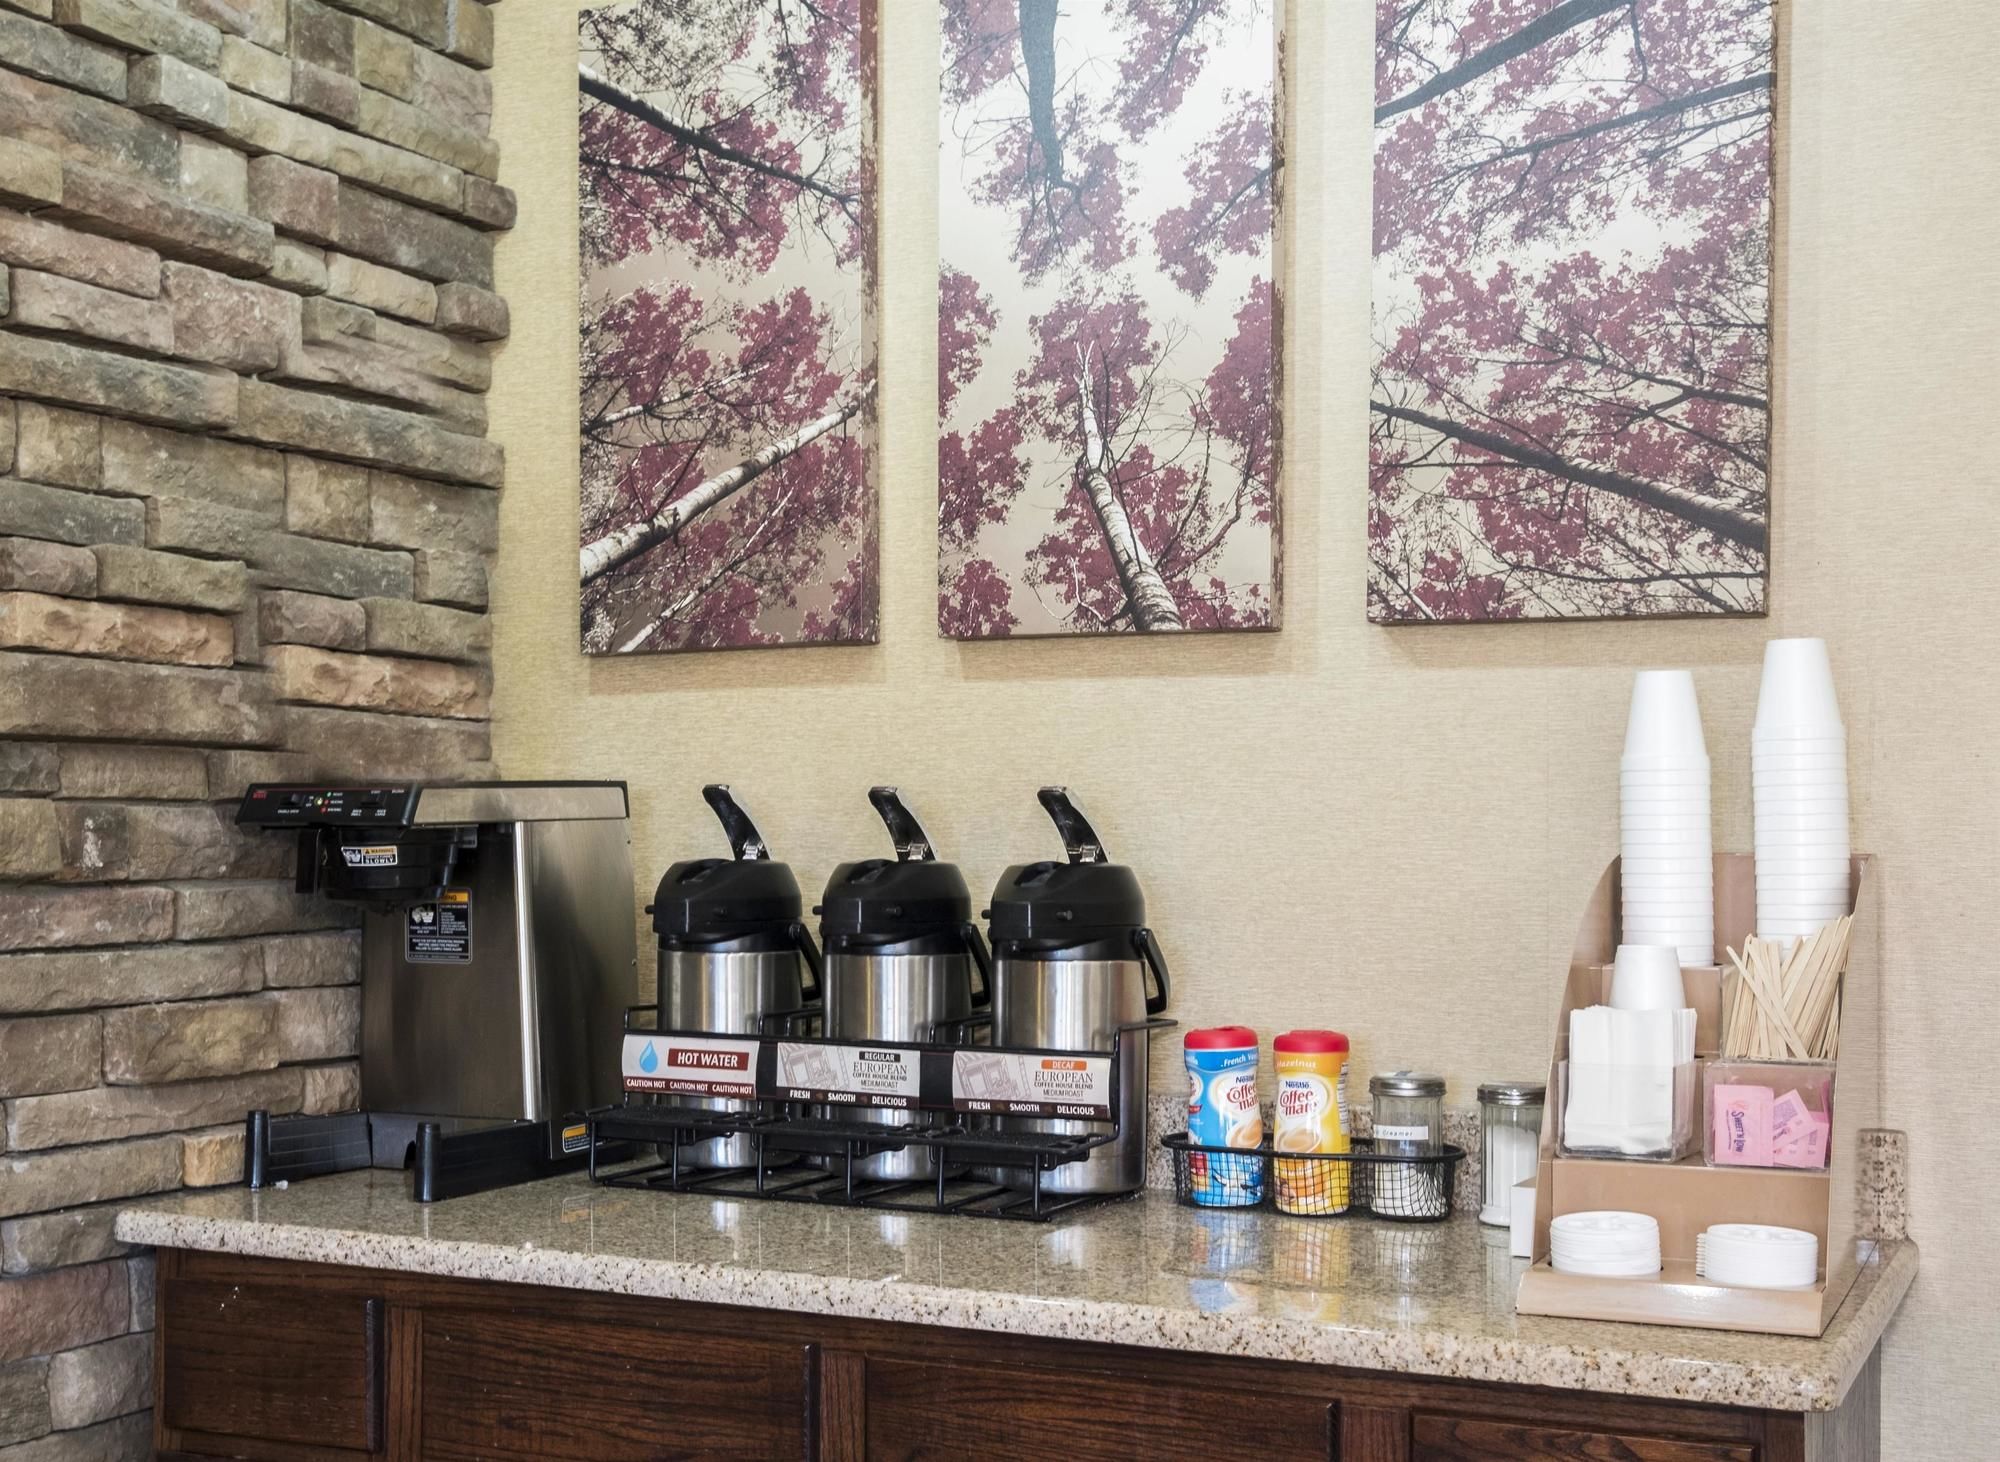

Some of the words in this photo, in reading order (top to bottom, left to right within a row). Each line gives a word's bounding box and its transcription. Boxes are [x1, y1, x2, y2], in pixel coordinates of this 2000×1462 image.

[677, 1052, 699, 1065] HOT
[701, 1053, 738, 1067] WATER
[864, 1052, 895, 1061] REGULAR
[1223, 1053, 1246, 1067] French
[853, 1062, 908, 1075] EUROPEAN
[1052, 1061, 1075, 1070] DECAF
[1034, 1071, 1094, 1083] EUROPEAN
[626, 1078, 653, 1088] CAUTION
[653, 1080, 666, 1089] HOT
[669, 1082, 696, 1091] CAUTION
[696, 1083, 709, 1092] HOT
[712, 1084, 739, 1094] CAUTION
[740, 1086, 753, 1095] HOT
[790, 1090, 811, 1099] FRESH
[828, 1092, 856, 1102] SMOOTH
[872, 1095, 907, 1107] DELICIOUS
[1280, 1090, 1314, 1108] Coffee
[968, 1101, 991, 1110] FRESH
[1009, 1103, 1040, 1112] SMOOTH
[1057, 1105, 1095, 1115] DELICIOUS
